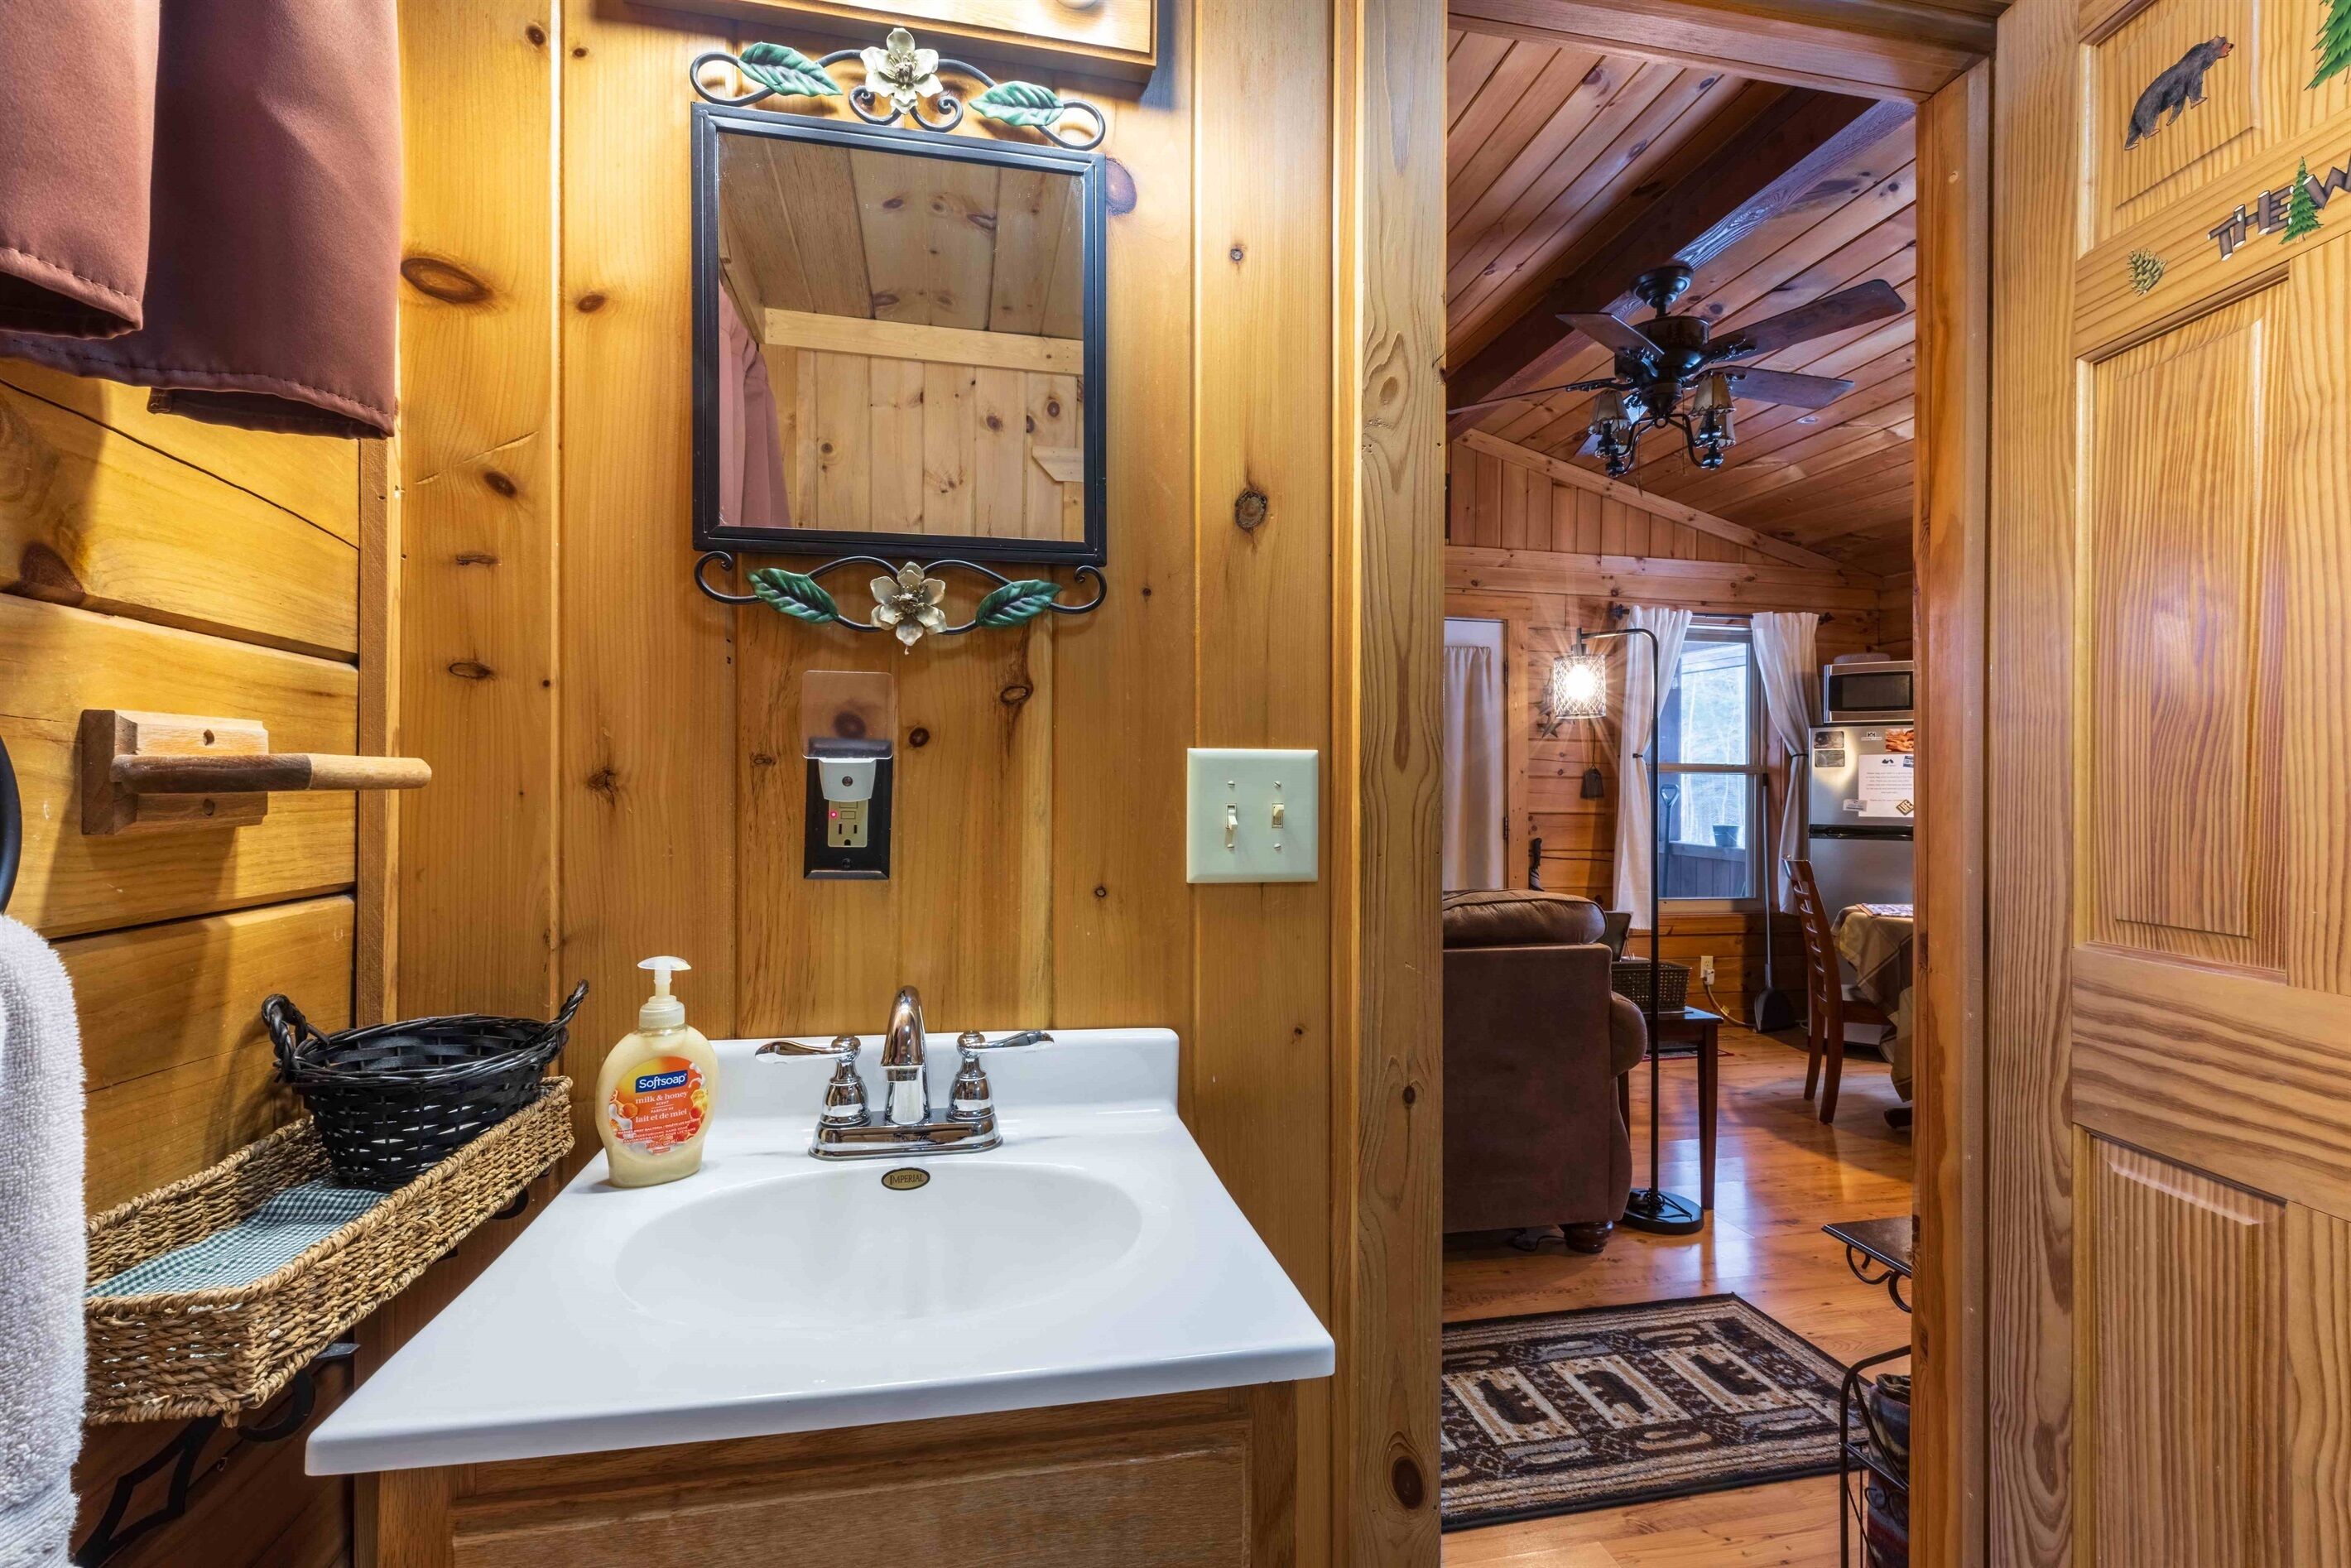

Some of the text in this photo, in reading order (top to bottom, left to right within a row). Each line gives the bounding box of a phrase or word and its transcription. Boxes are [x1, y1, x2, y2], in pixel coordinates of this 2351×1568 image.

[2207, 184, 2294, 262] THE
[635, 1095, 656, 1104] milk
[665, 1091, 689, 1100] honey
[670, 1108, 687, 1118] miel
[889, 1174, 924, 1186] IMPERIAL
